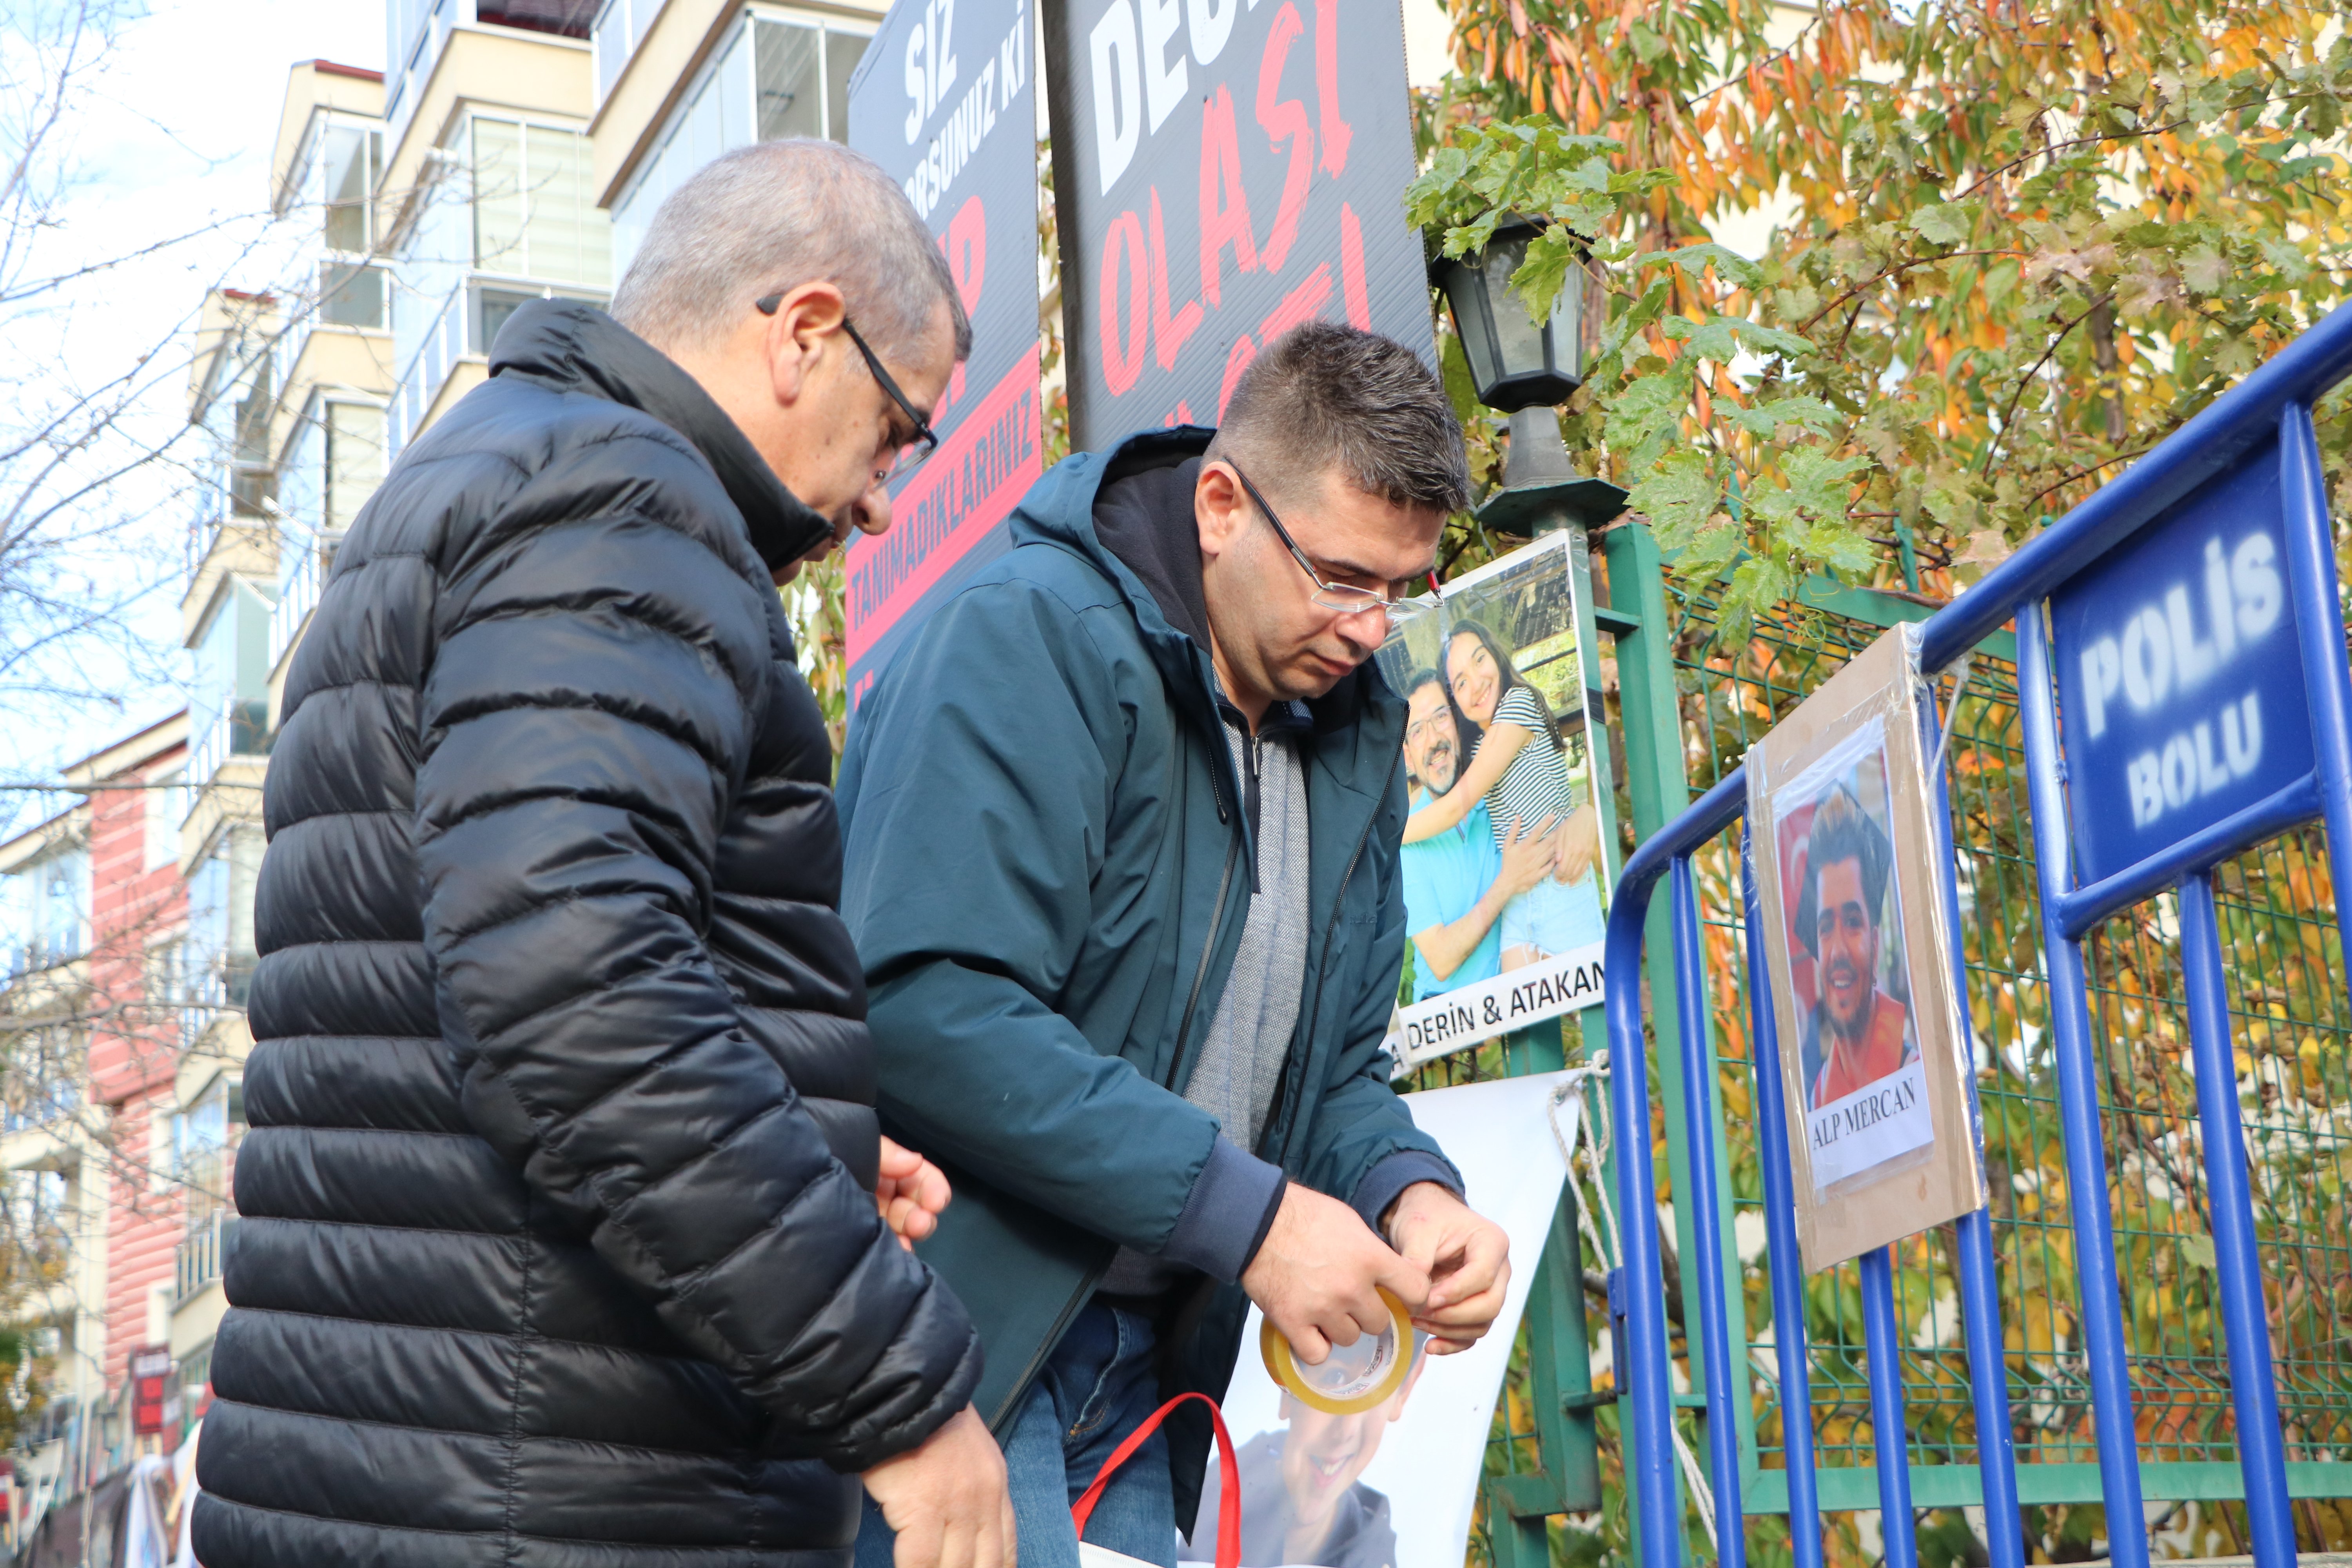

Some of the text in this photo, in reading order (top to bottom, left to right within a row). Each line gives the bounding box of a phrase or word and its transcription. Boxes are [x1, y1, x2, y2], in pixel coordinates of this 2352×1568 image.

[852, 386, 1033, 632] TANIMADIKLARINIZ
[2081, 531, 2283, 742] POLİS
[2127, 688, 2264, 831] BOLU
[1407, 1001, 1475, 1050] DERİN
[1483, 994, 1502, 1025] &
[1813, 1077, 1915, 1150] ALP MERCAN
